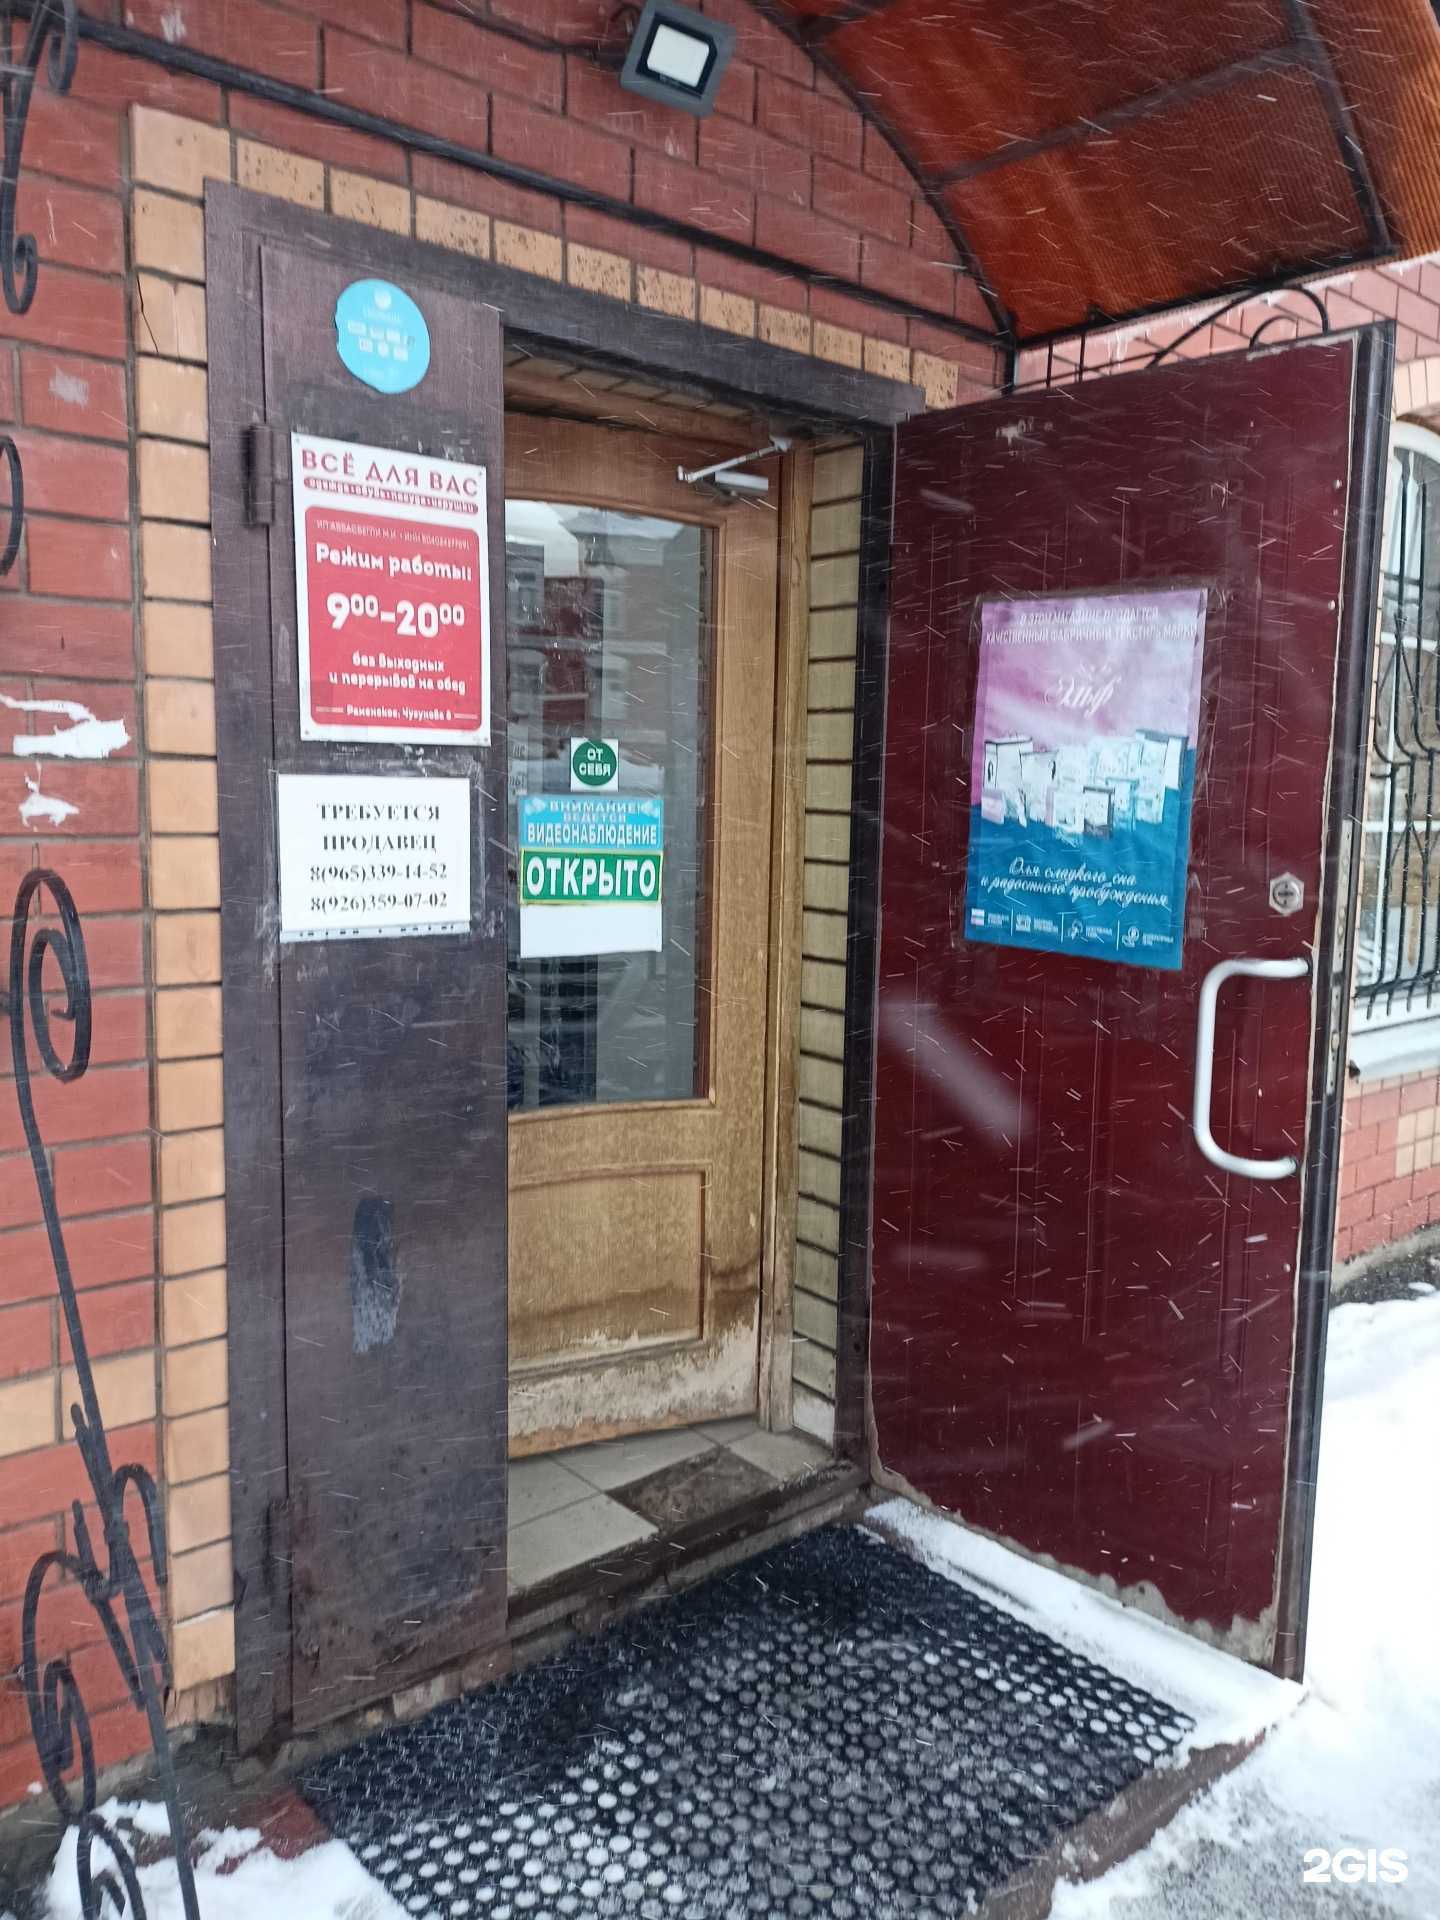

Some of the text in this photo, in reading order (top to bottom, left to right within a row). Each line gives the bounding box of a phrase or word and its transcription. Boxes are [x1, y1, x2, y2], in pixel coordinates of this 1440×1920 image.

[302, 449, 478, 496] ВСЁ ДЛЯ ВАС
[316, 542, 384, 570] Режим
[352, 651, 444, 674] без выходных
[329, 672, 337, 684] и
[418, 679, 434, 690] на
[437, 676, 466, 695] обед
[587, 748, 603, 761] ОТ
[579, 762, 611, 777] СЕБЯ
[316, 803, 440, 822] ТРЕБУЕТСЯ
[321, 834, 438, 854] ПРОДАВЕЦ
[527, 823, 657, 847] ВИДЕОНАБЛЮДЕНИЕ
[310, 863, 447, 884] 8(965)339-14-52
[526, 856, 656, 897] ОТКРЫТО
[1008, 856, 1137, 886] Для сладкого сна
[988, 876, 1066, 896] радостного
[310, 893, 447, 914] 8(926)359-07-02
